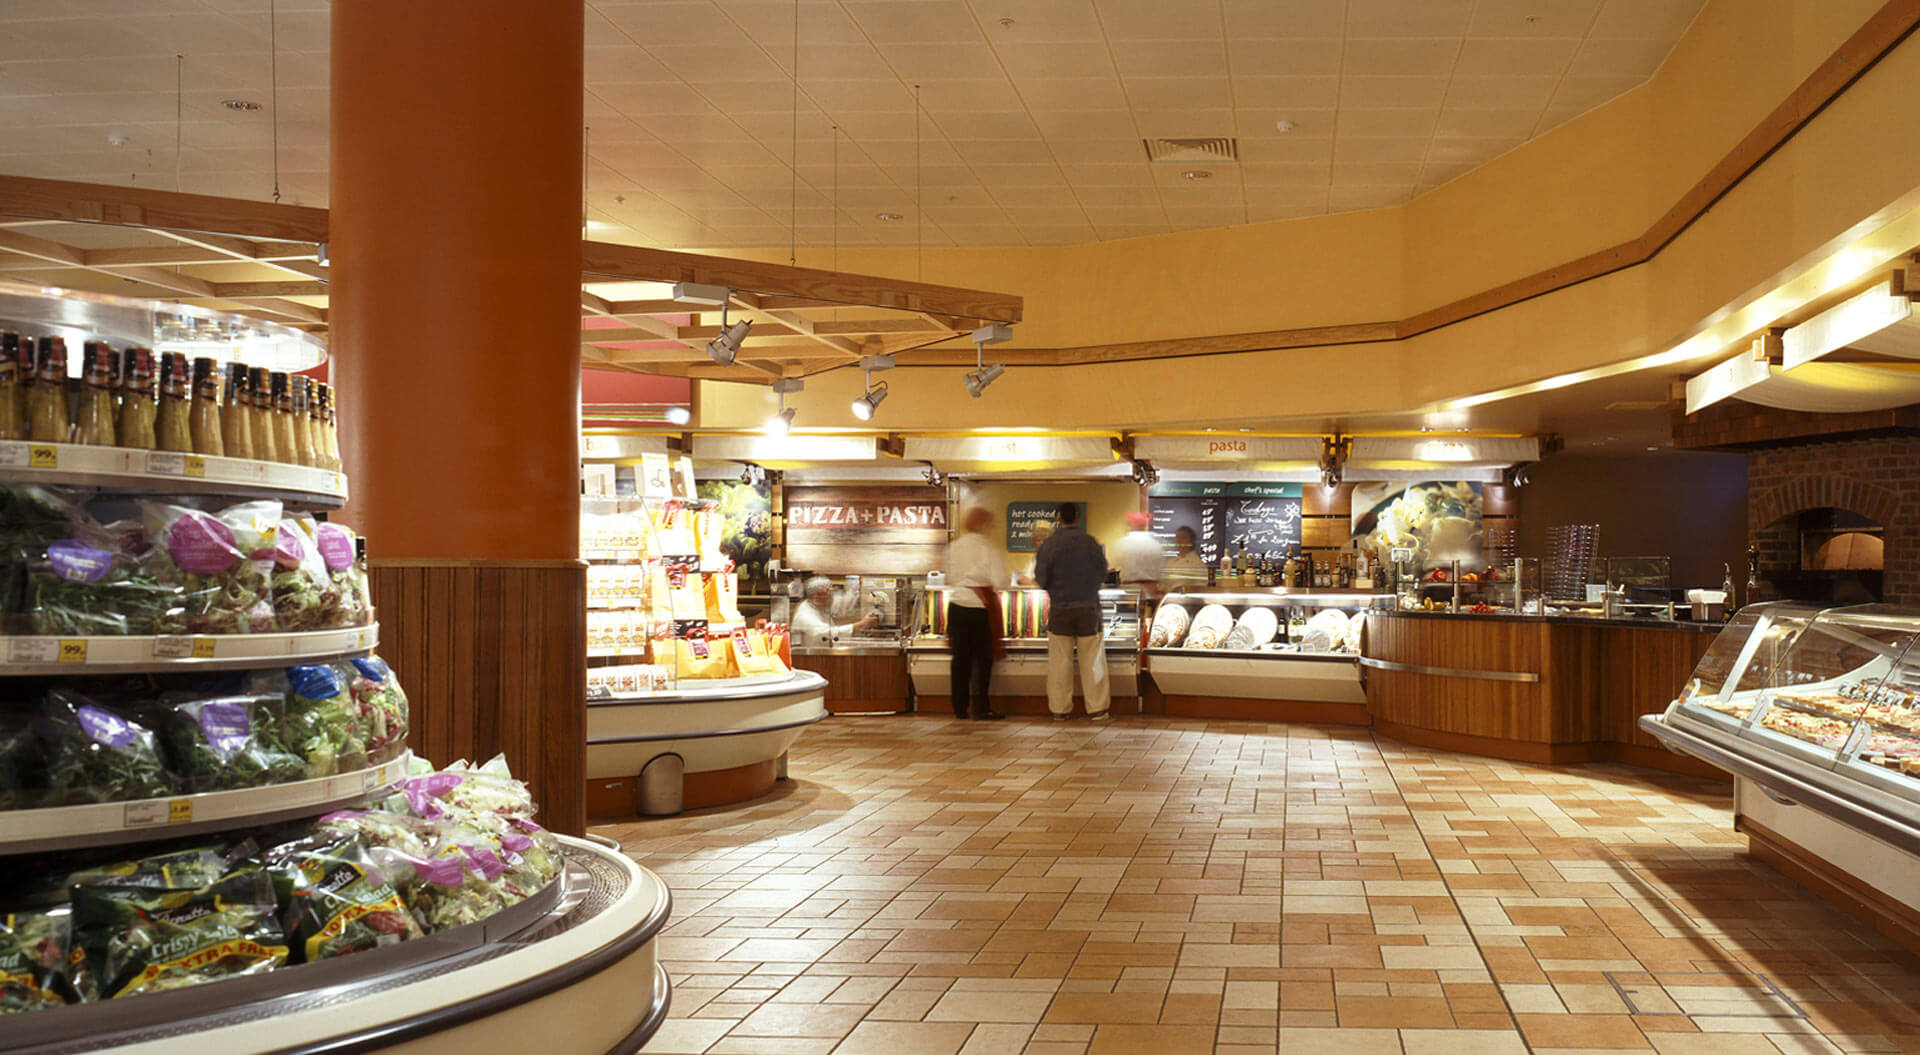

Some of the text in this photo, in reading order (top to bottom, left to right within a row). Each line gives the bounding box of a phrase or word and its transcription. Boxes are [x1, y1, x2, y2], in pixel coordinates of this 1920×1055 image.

[1209, 439, 1247, 455] pasta
[789, 505, 859, 525] PIZZA
[876, 505, 945, 525] PASTA
[1011, 508, 1026, 518] hot
[1027, 508, 1057, 518] cooked
[168, 944, 233, 968] XTRA
